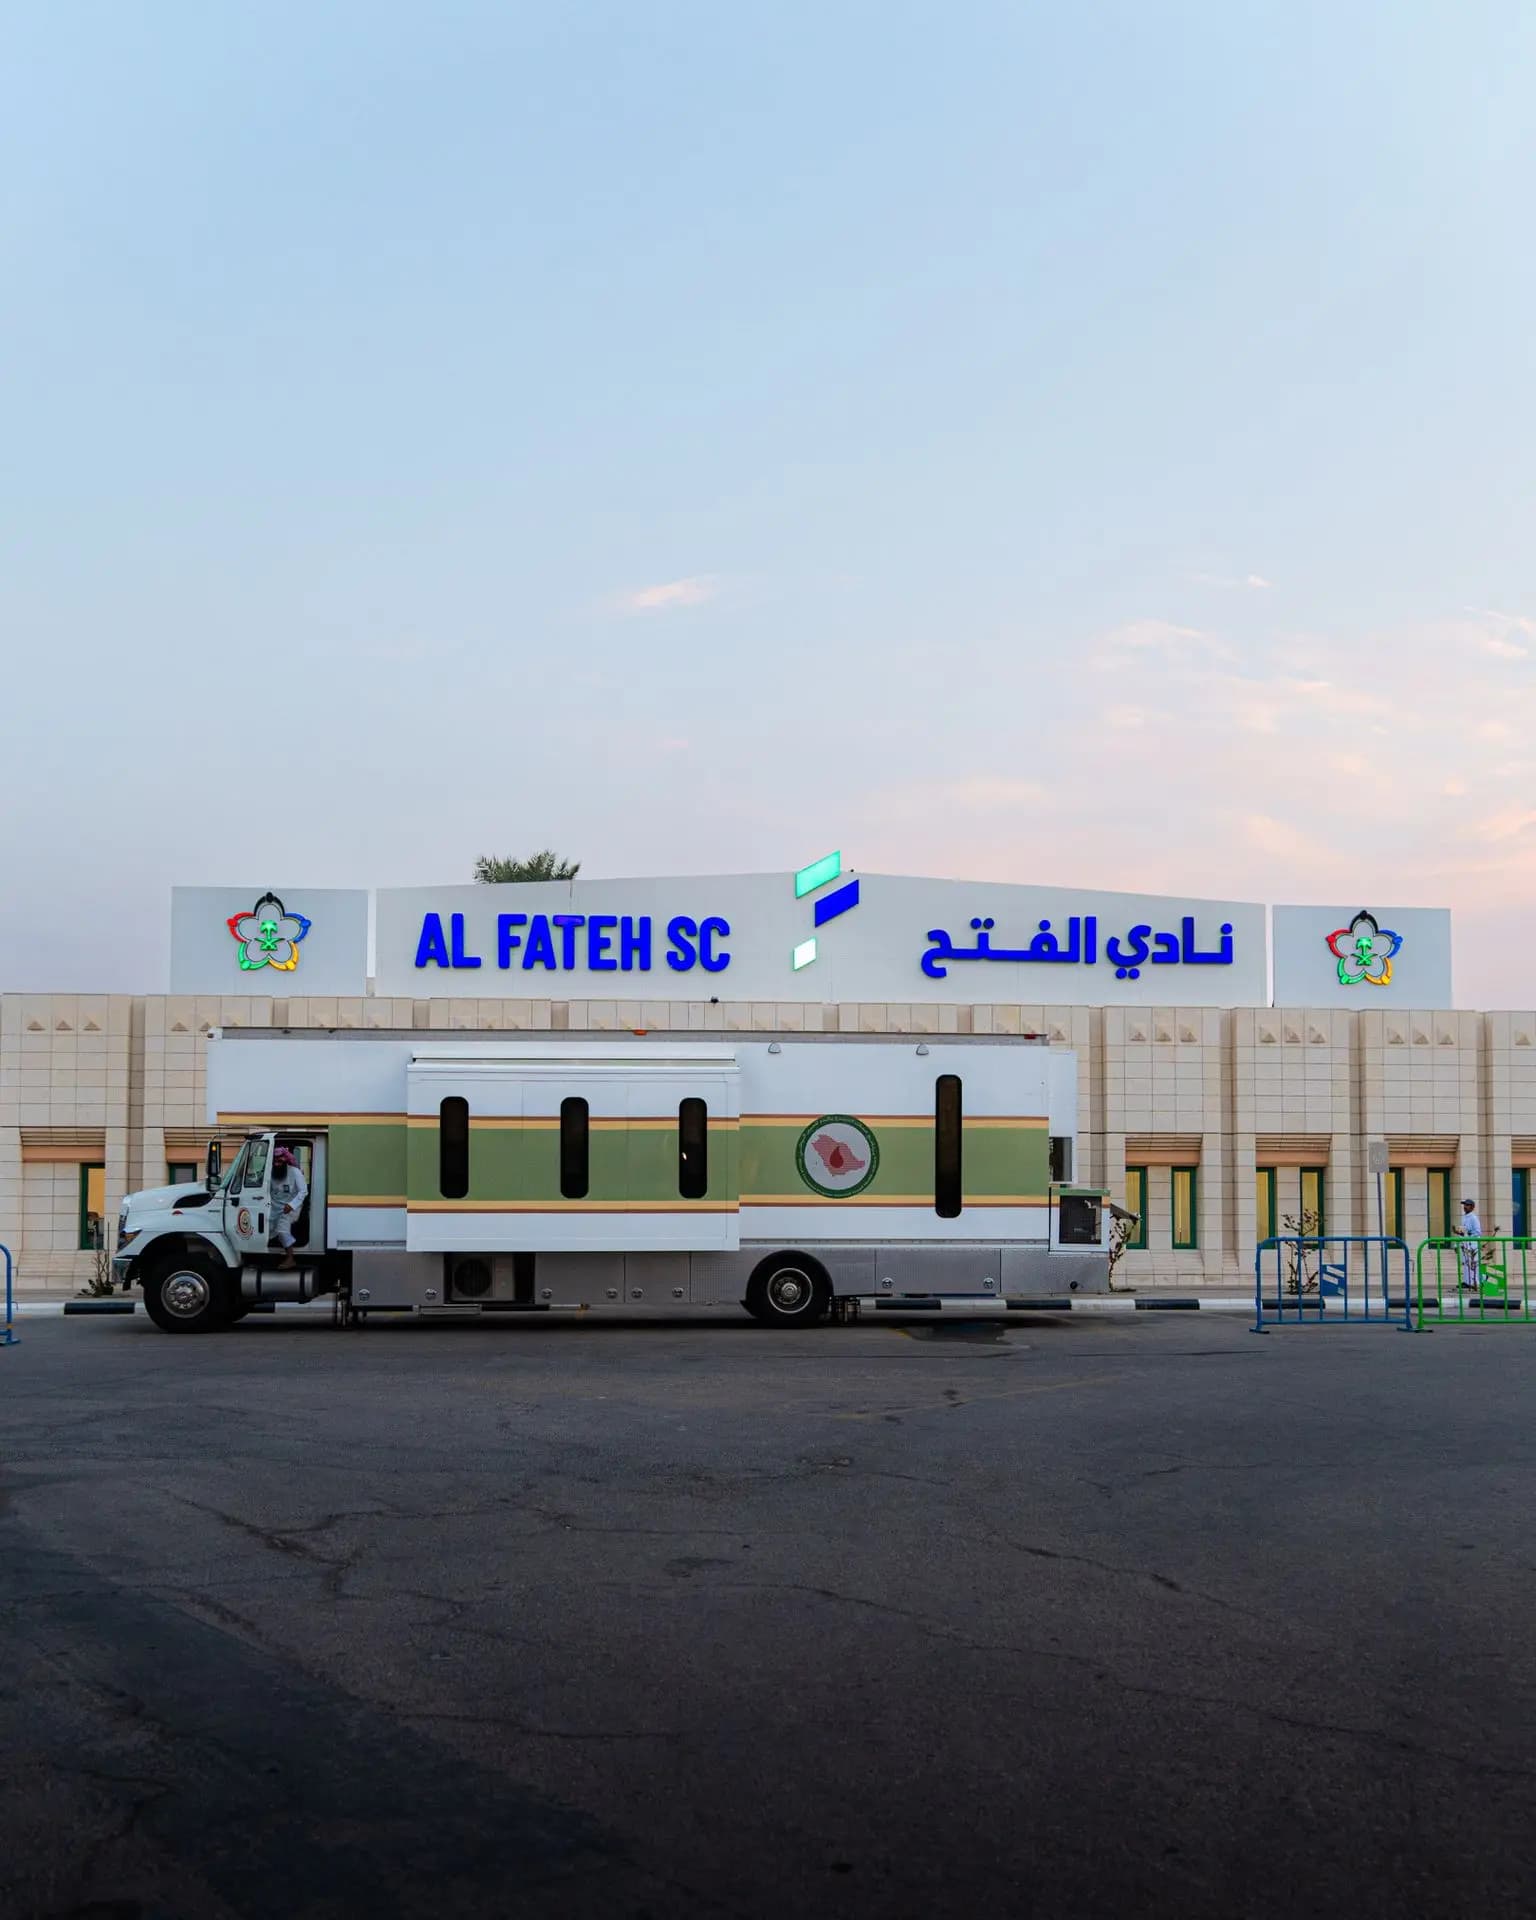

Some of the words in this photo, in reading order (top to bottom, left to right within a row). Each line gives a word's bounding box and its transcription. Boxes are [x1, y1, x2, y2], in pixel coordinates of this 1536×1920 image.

[415, 912, 482, 968] AL
[497, 913, 652, 971] FATEH
[666, 915, 731, 973] SC
[921, 915, 1097, 979] الفتح
[1106, 916, 1234, 980] نادي
